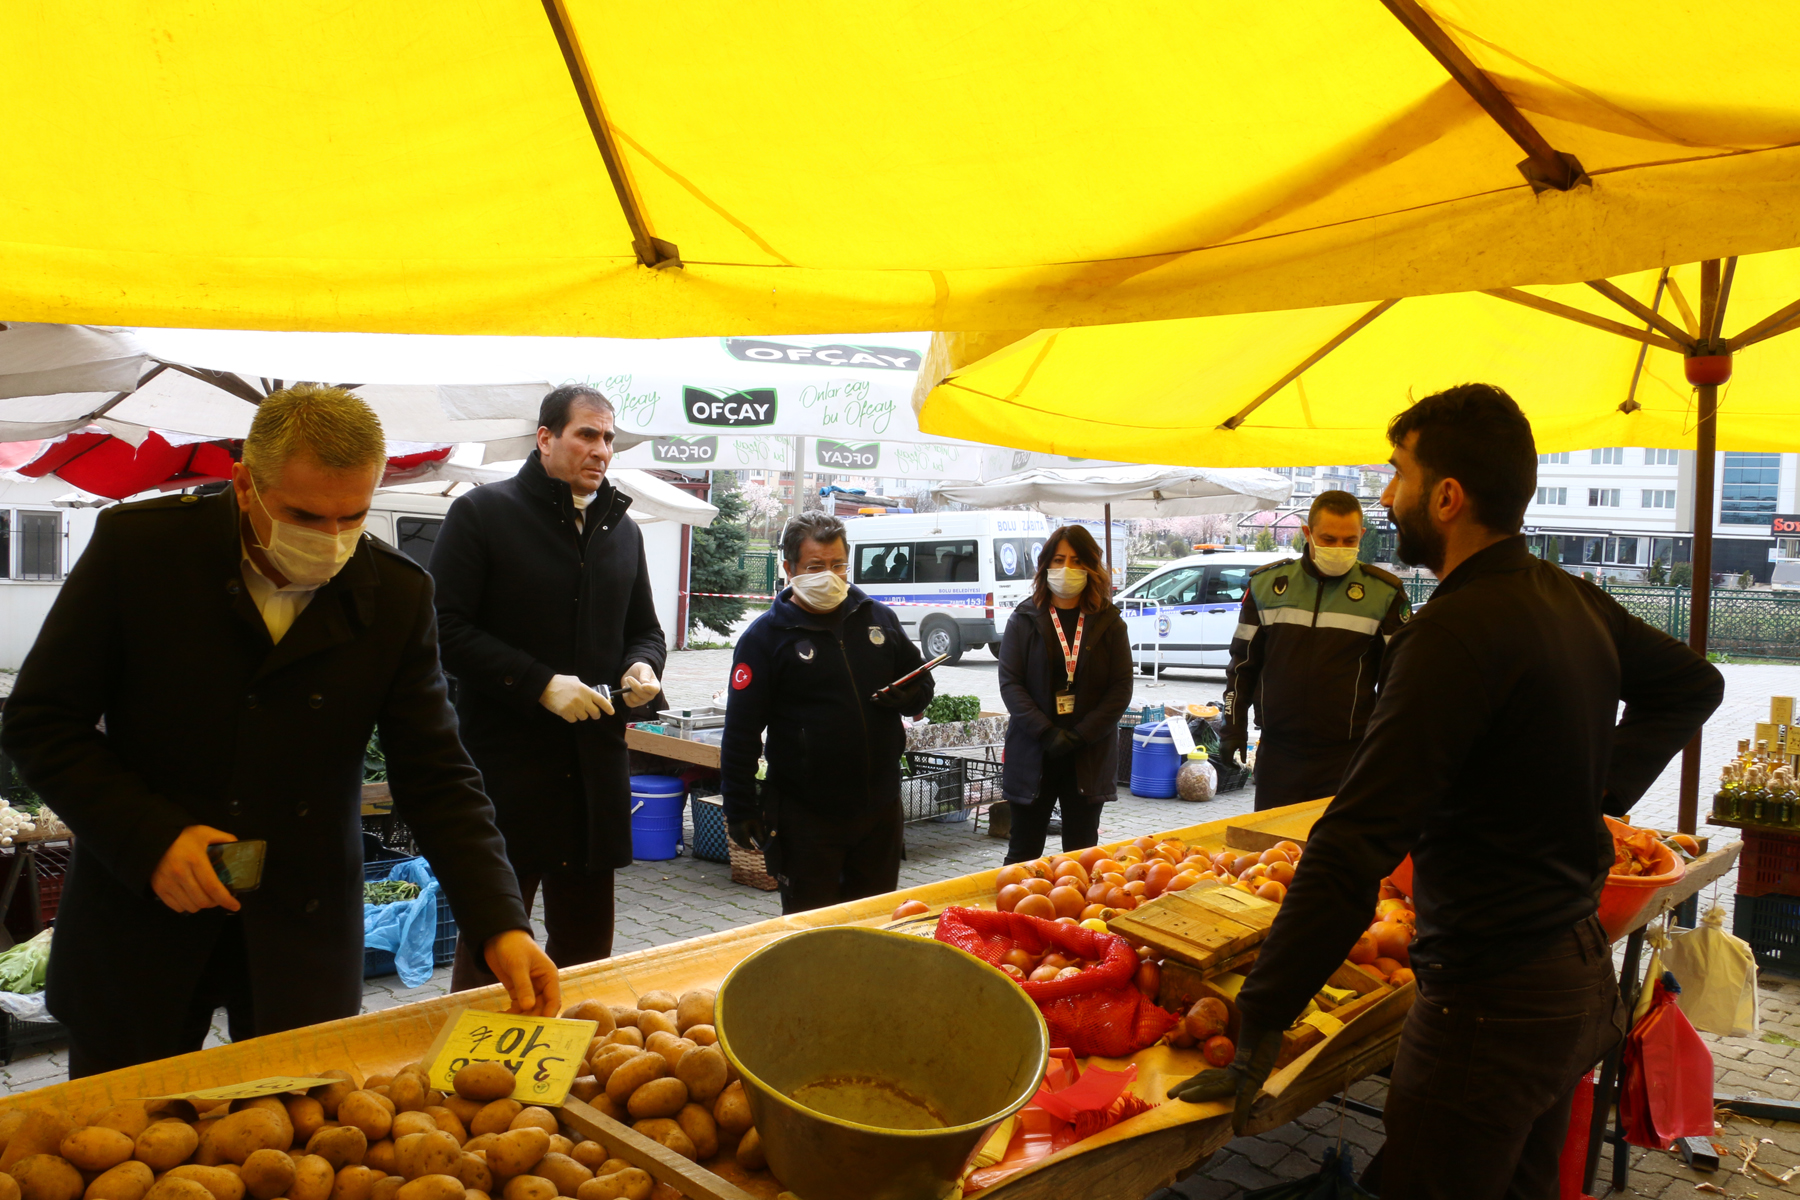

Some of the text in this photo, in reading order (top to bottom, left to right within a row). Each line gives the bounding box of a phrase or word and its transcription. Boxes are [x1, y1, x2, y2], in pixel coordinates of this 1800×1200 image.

[745, 347, 912, 369] OFÇAY
[799, 382, 842, 408] Onlar
[692, 402, 770, 424] OFÇAY
[823, 400, 897, 434] bu Ofçay
[997, 520, 1045, 532] BOLU ZABITA
[966, 597, 982, 606] 153
[1224, 691, 1235, 716] ZABITA
[533, 1056, 565, 1082] 3
